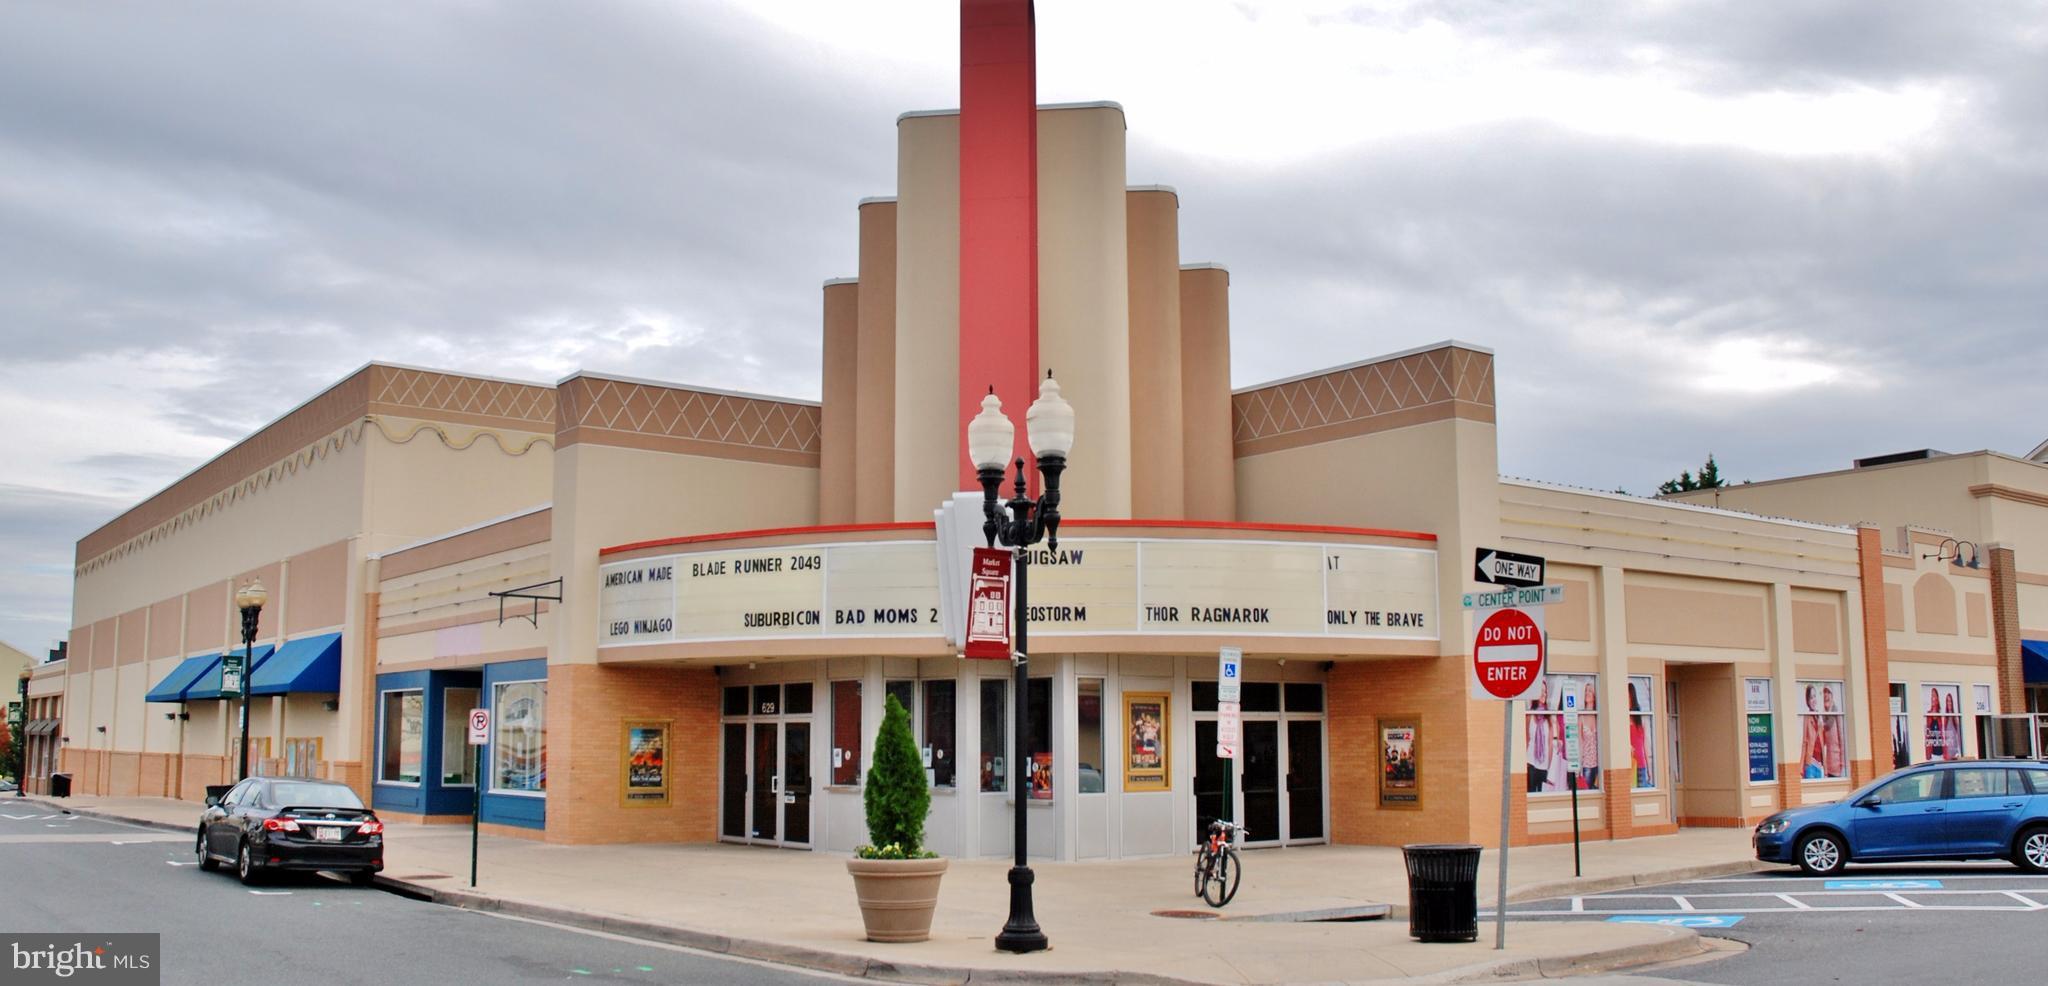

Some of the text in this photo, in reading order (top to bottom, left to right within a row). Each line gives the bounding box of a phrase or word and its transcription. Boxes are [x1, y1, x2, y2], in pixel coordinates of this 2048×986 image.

[983, 558, 1000, 566] Market
[1027, 550, 1083, 565] JIGSAW
[692, 555, 821, 577] BLADE RUNNER 2049
[1495, 561, 1537, 579] ONE WAY
[605, 566, 672, 588] AMERICAN MADE
[1478, 592, 1514, 607] CENTER
[1519, 589, 1545, 603] POINT
[744, 610, 820, 627] SUBURBICON
[835, 608, 938, 624] BAD MOMS 2
[1145, 607, 1269, 622] THOR RAGNAROK
[1327, 610, 1424, 627] ONLY THE BRAVE
[610, 618, 673, 636] LEGO NINJAGO
[1484, 625, 1533, 641] DO NOT
[1487, 666, 1527, 681] ENTER
[762, 702, 774, 713] 629
